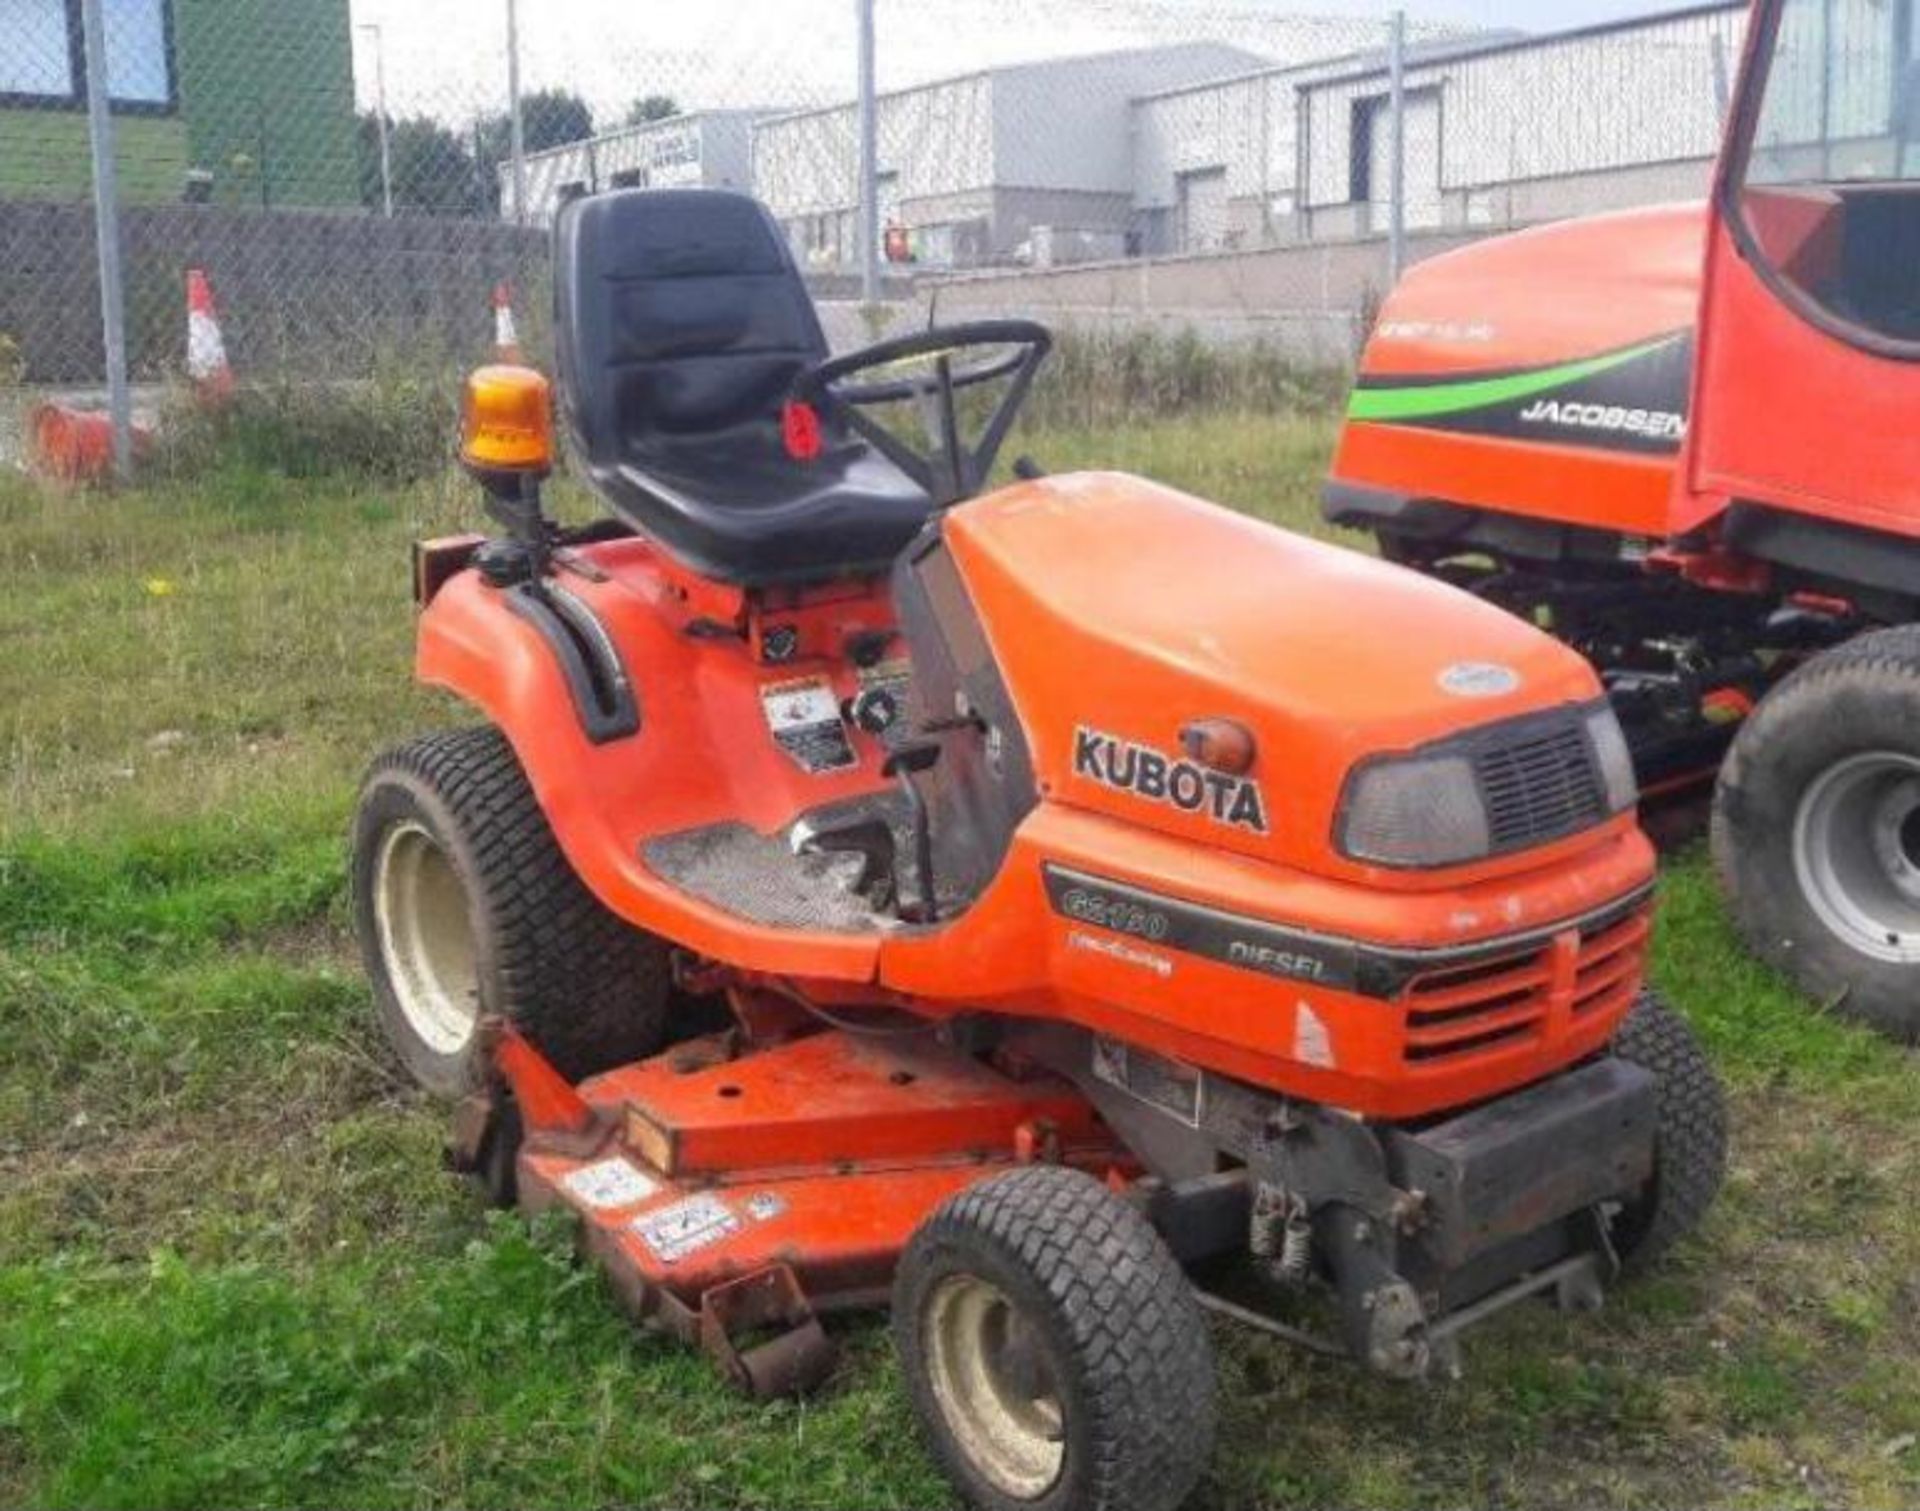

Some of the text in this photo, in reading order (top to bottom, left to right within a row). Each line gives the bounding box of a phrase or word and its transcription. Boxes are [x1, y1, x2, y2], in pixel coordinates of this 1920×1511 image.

[1522, 400, 1686, 436] JACOBSEN
[1075, 728, 1267, 831] KUBOTA
[1230, 941, 1327, 979] DIESEL
